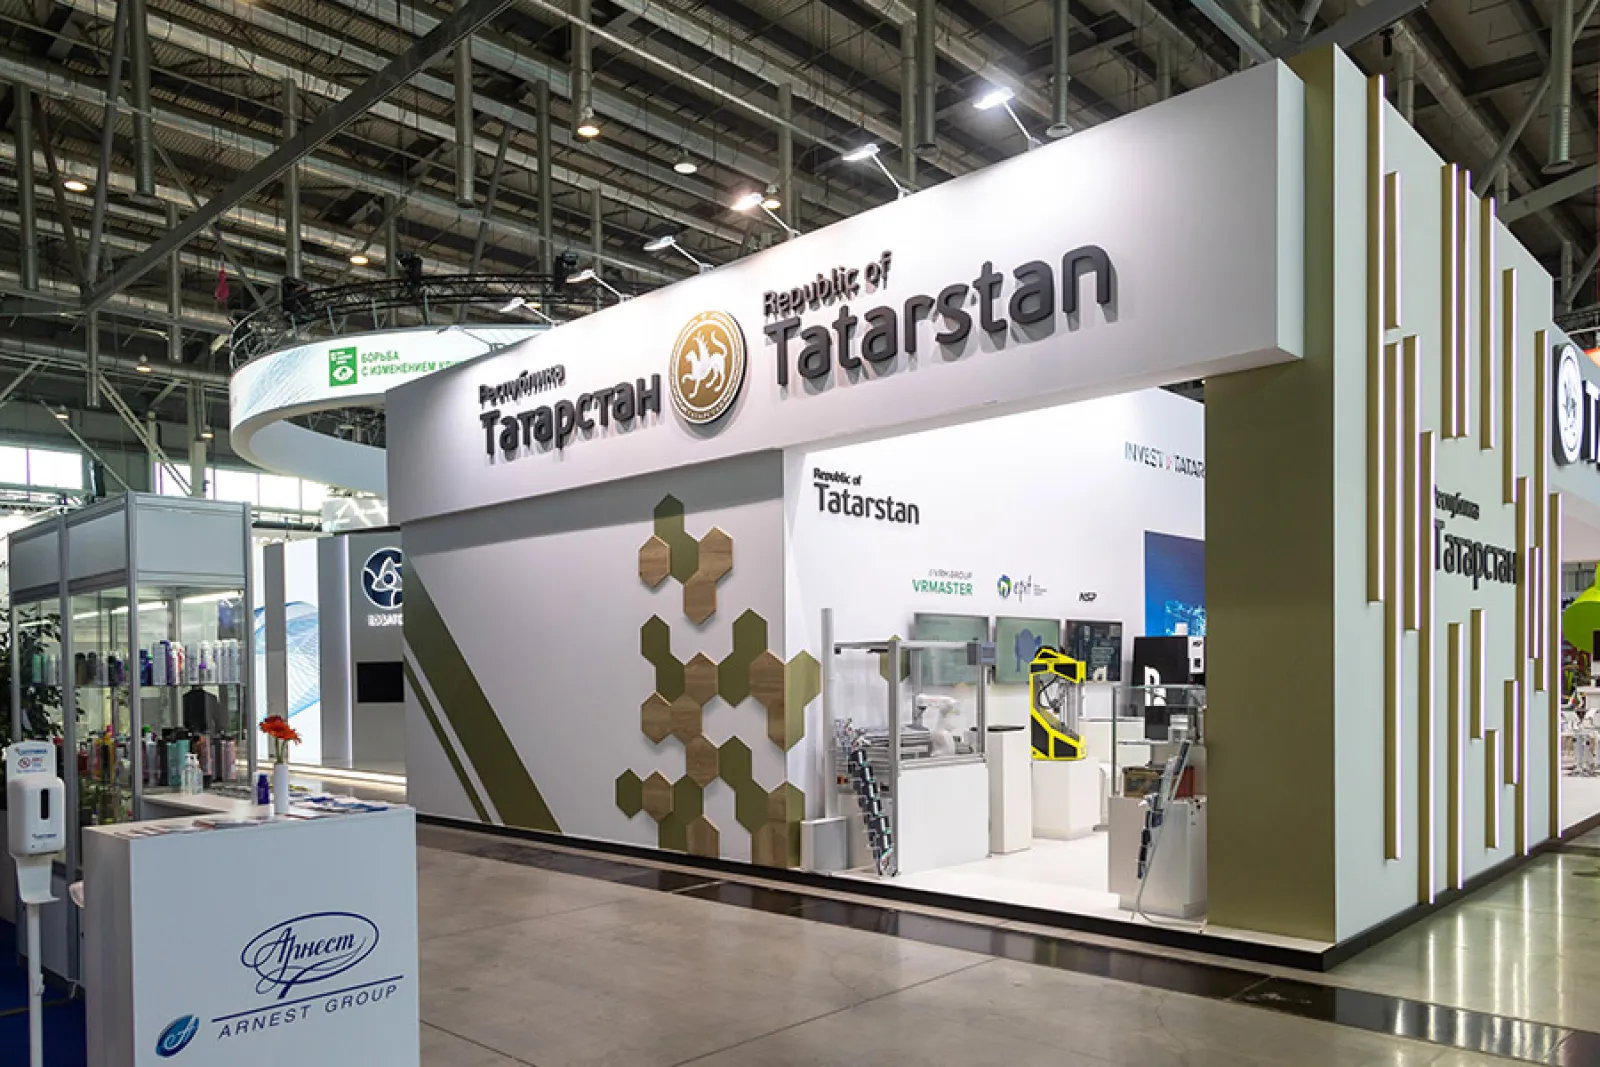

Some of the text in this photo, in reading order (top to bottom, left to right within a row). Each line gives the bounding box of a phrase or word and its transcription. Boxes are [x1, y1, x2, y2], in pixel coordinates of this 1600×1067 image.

[763, 250, 891, 317] Republic of
[764, 245, 1111, 385] Tatarstan
[360, 350, 400, 363] БОРЬБА
[369, 361, 436, 376] ИЗМЕНЕНИЕМ
[479, 364, 565, 405] Республика
[480, 374, 661, 456] Татарстан
[1124, 441, 1163, 469] INVEST
[813, 467, 862, 486] Republic of
[813, 482, 920, 525] Tatarstan
[912, 579, 973, 596] VRMASTER
[217, 984, 397, 1040] ARNEST GROUP
